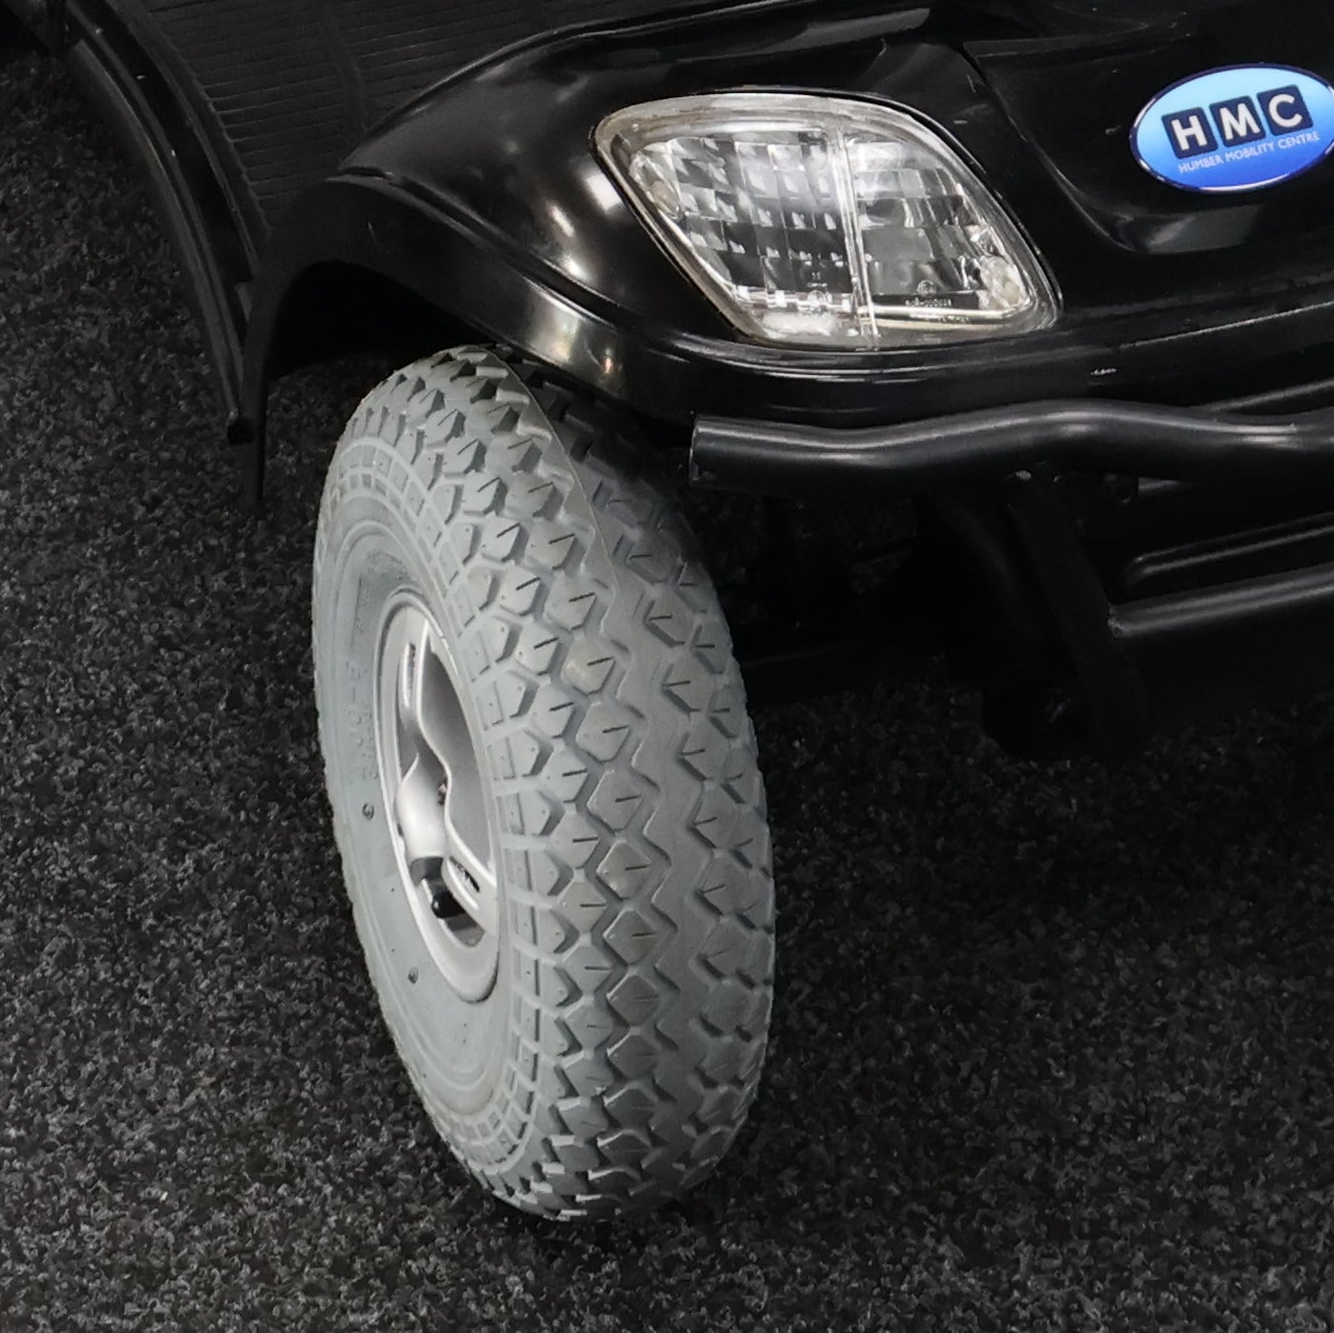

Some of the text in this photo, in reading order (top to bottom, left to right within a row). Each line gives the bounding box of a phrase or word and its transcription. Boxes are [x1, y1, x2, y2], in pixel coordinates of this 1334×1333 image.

[1170, 91, 1304, 152] HMC
[1178, 130, 1321, 174] HUMBER MOBILITY CENTRE
